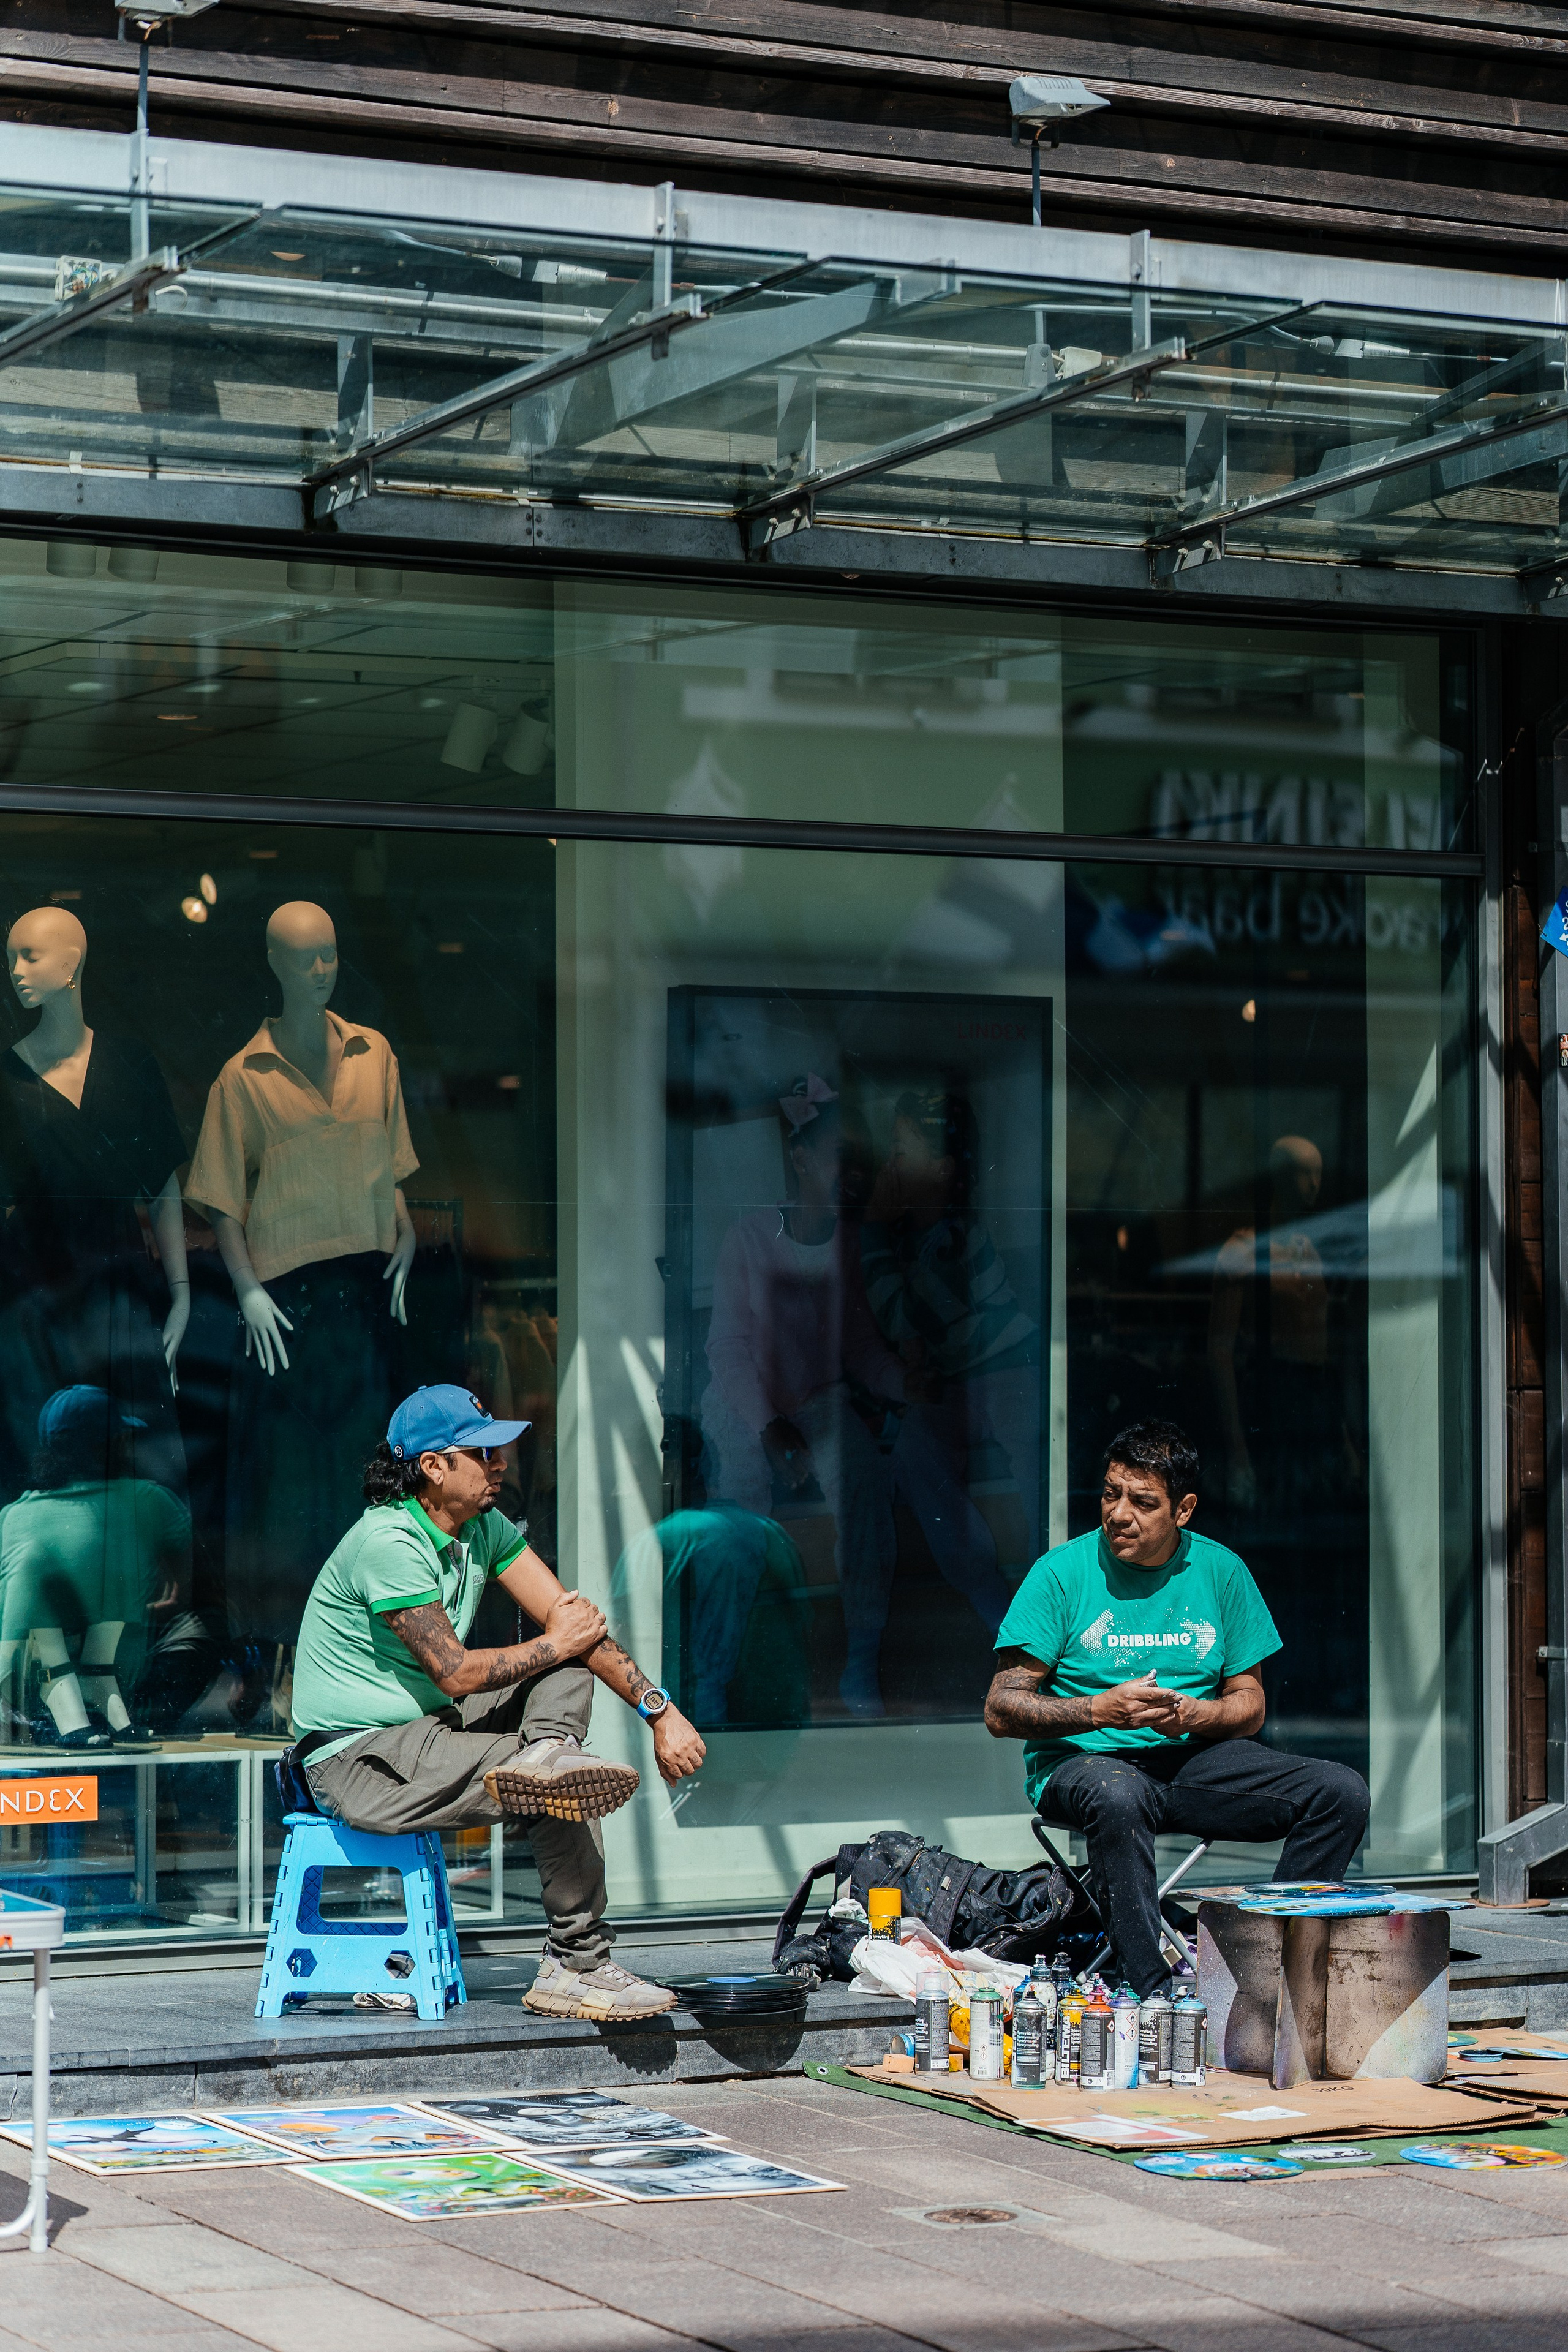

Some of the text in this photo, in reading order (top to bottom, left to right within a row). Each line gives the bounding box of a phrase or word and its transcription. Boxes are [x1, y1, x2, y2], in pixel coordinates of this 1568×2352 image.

[958, 1023, 1027, 1040] LINDEX
[1107, 1632, 1191, 1647] DRIBBLING
[1061, 2016, 1071, 2079] BILTEMA
